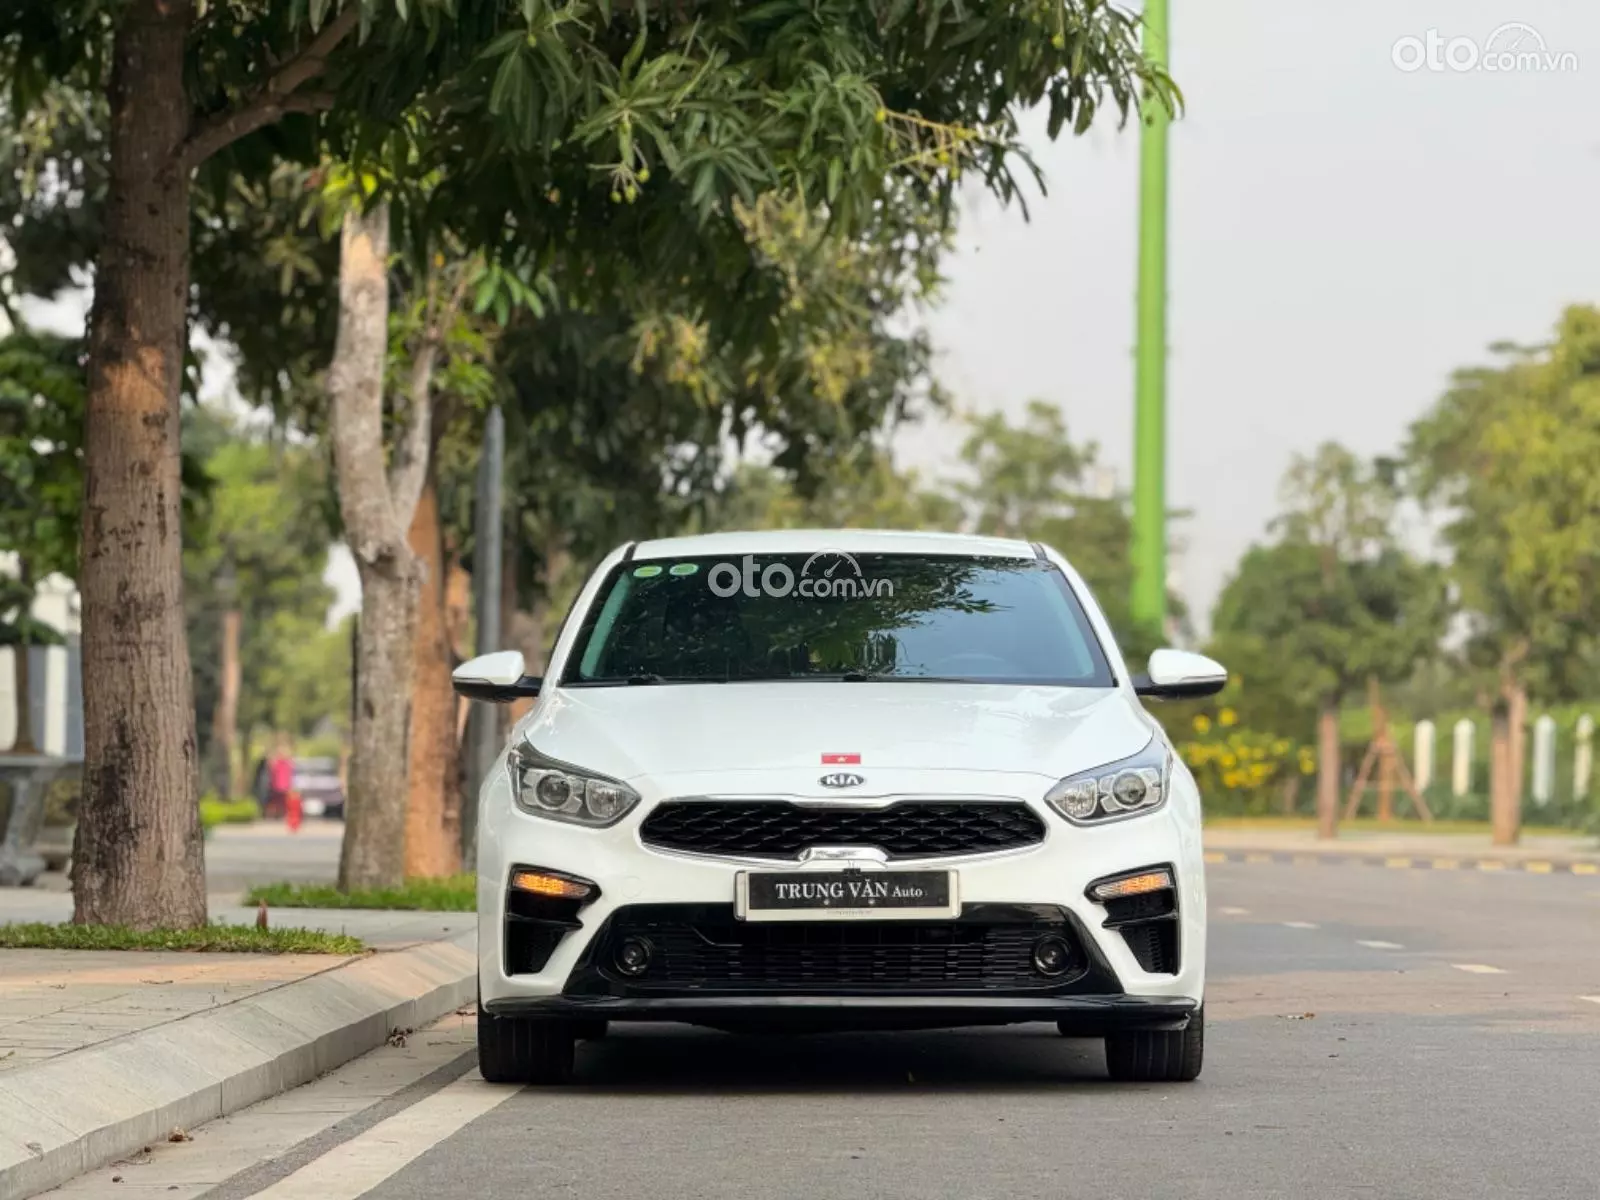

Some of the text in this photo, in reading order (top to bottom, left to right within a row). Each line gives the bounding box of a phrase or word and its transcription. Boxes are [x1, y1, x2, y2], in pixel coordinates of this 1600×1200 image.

[826, 774, 859, 785] KIA
[775, 882, 844, 900] TRUNG
[892, 886, 923, 898] Auto
